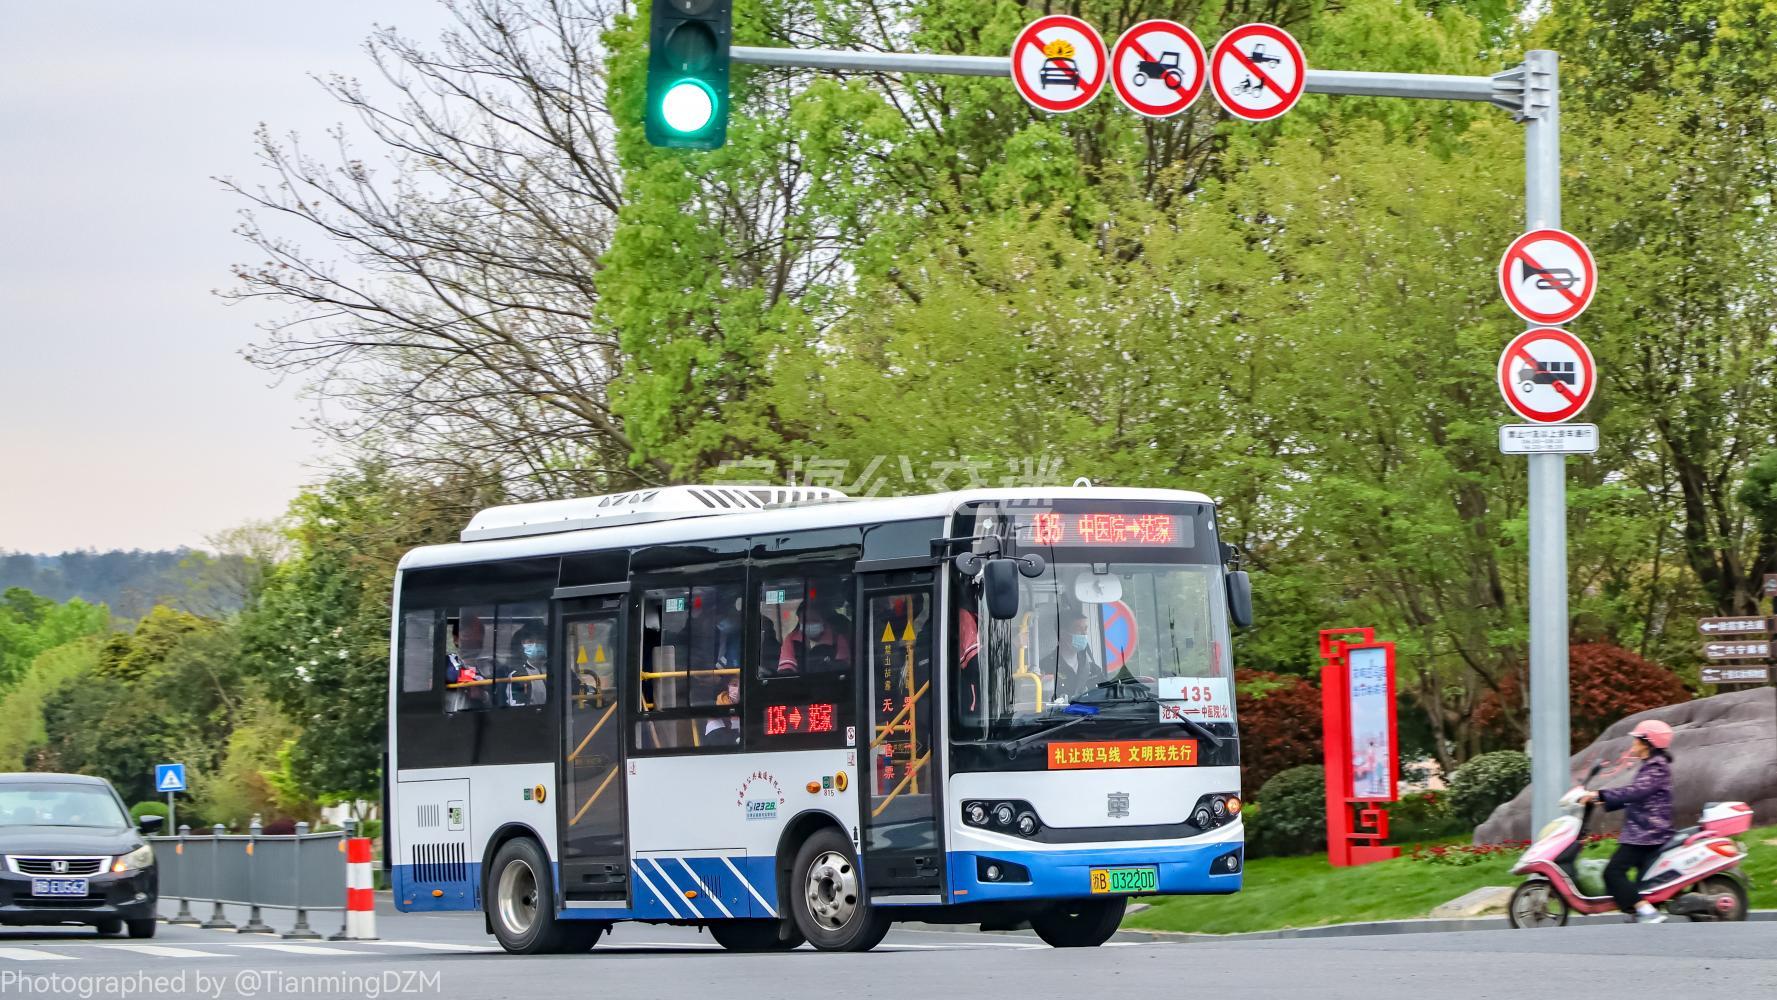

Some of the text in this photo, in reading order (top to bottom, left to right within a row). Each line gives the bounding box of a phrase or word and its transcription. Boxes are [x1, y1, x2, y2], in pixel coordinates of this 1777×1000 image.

[1034, 513, 1061, 543] 135
[1079, 514, 1126, 543] 中医院
[1139, 514, 1171, 543] 范家
[1181, 686, 1212, 702] 135
[767, 705, 786, 735] 135
[1055, 745, 1192, 764] 礼让斑马线 文明我先行
[753, 802, 776, 811] 12328
